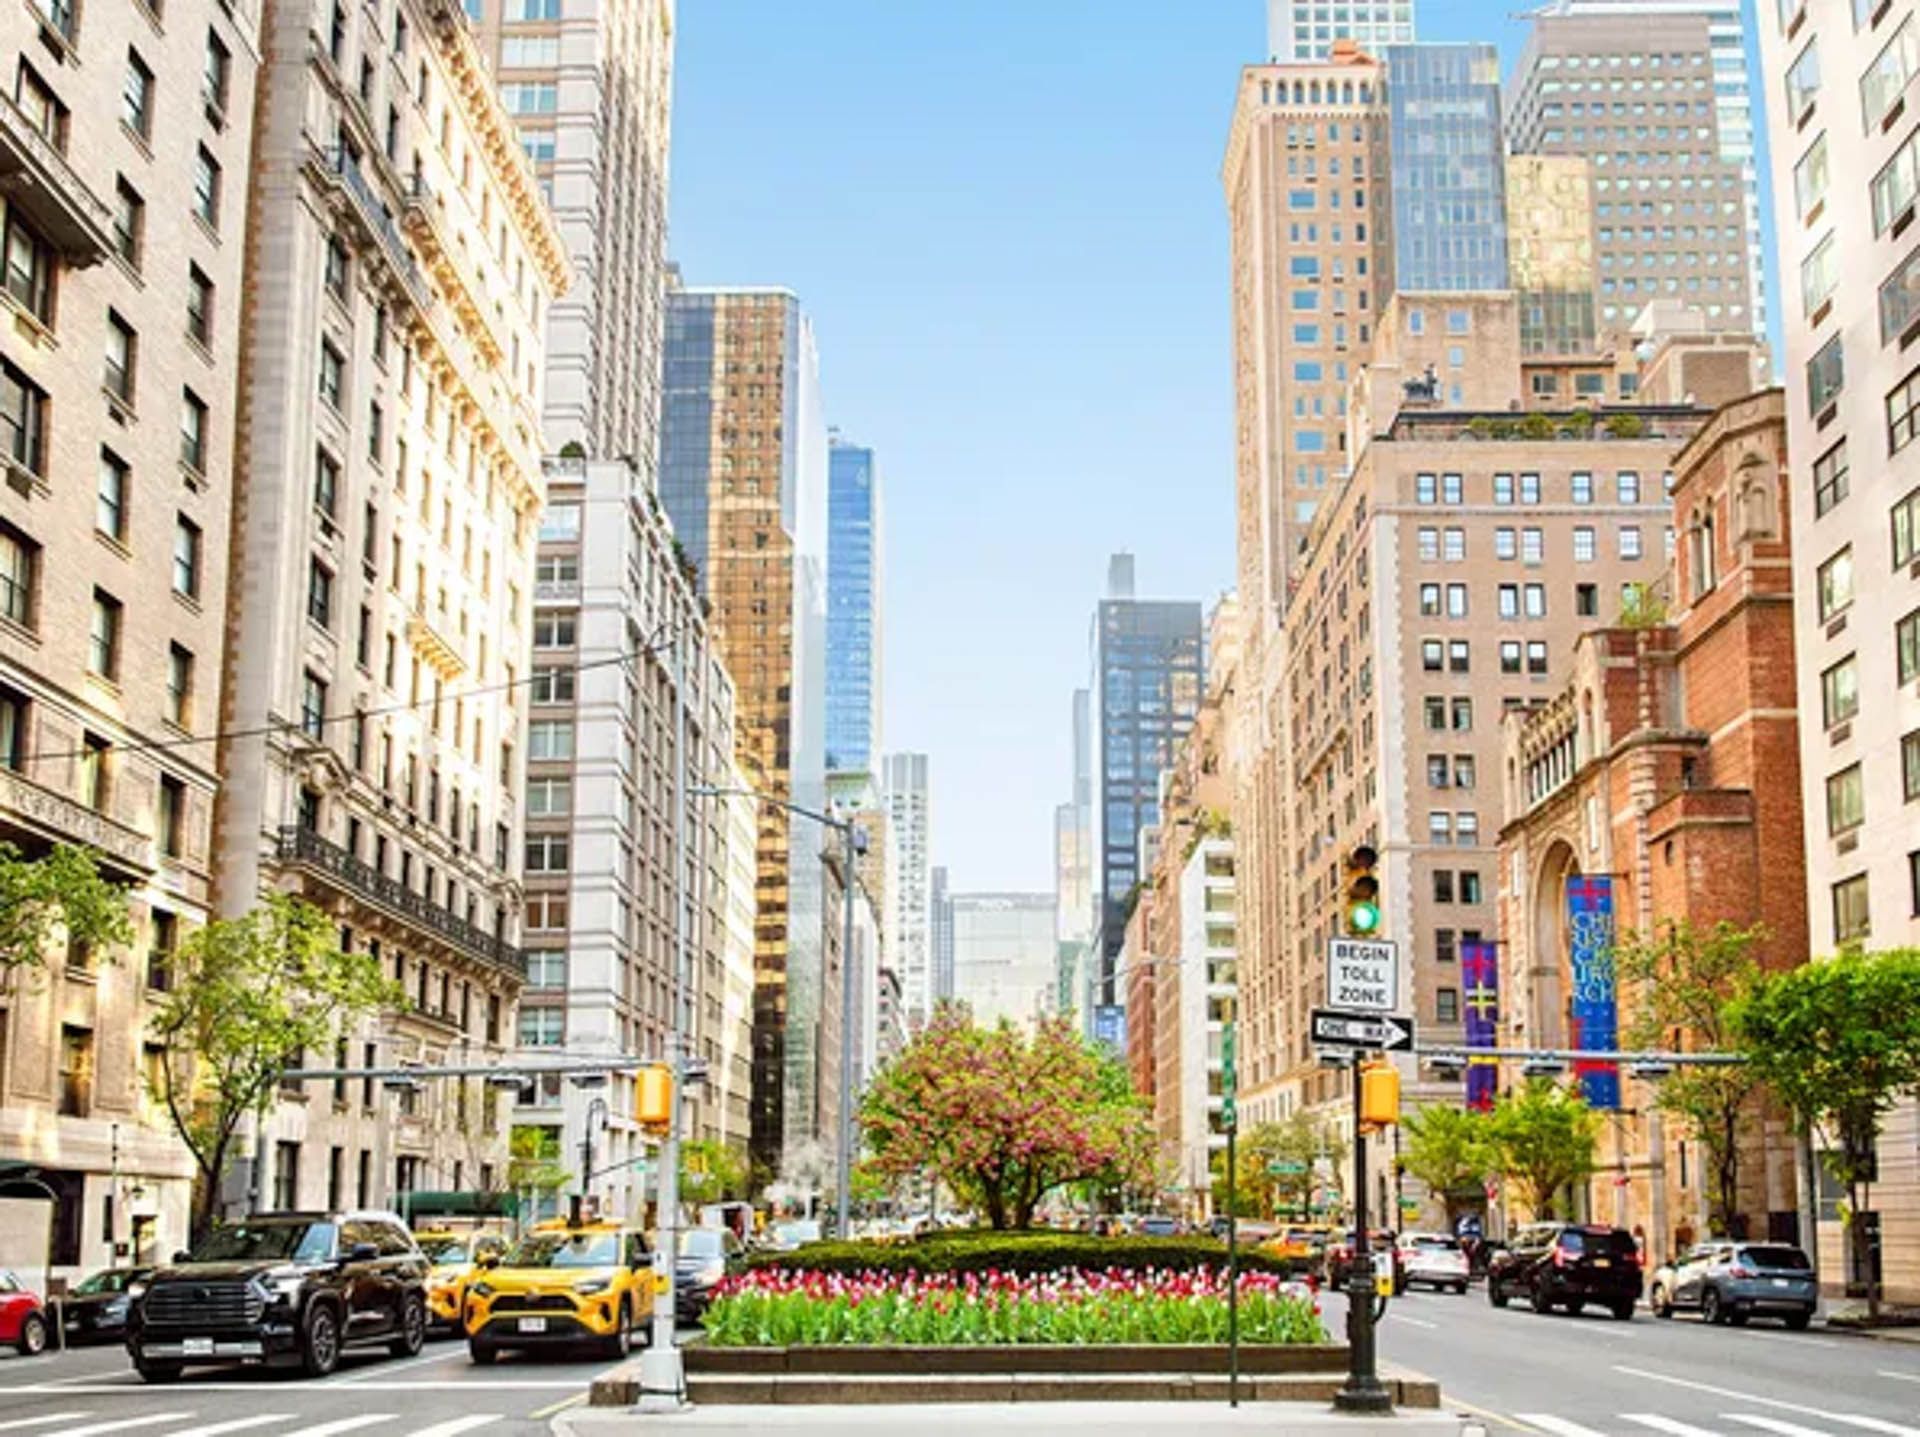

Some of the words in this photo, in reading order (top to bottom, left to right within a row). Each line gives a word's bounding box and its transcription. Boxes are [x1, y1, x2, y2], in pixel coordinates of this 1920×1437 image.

[1336, 944, 1389, 961] BEGIN
[1340, 965, 1385, 983] TOLL
[1339, 986, 1386, 1004] ZONE
